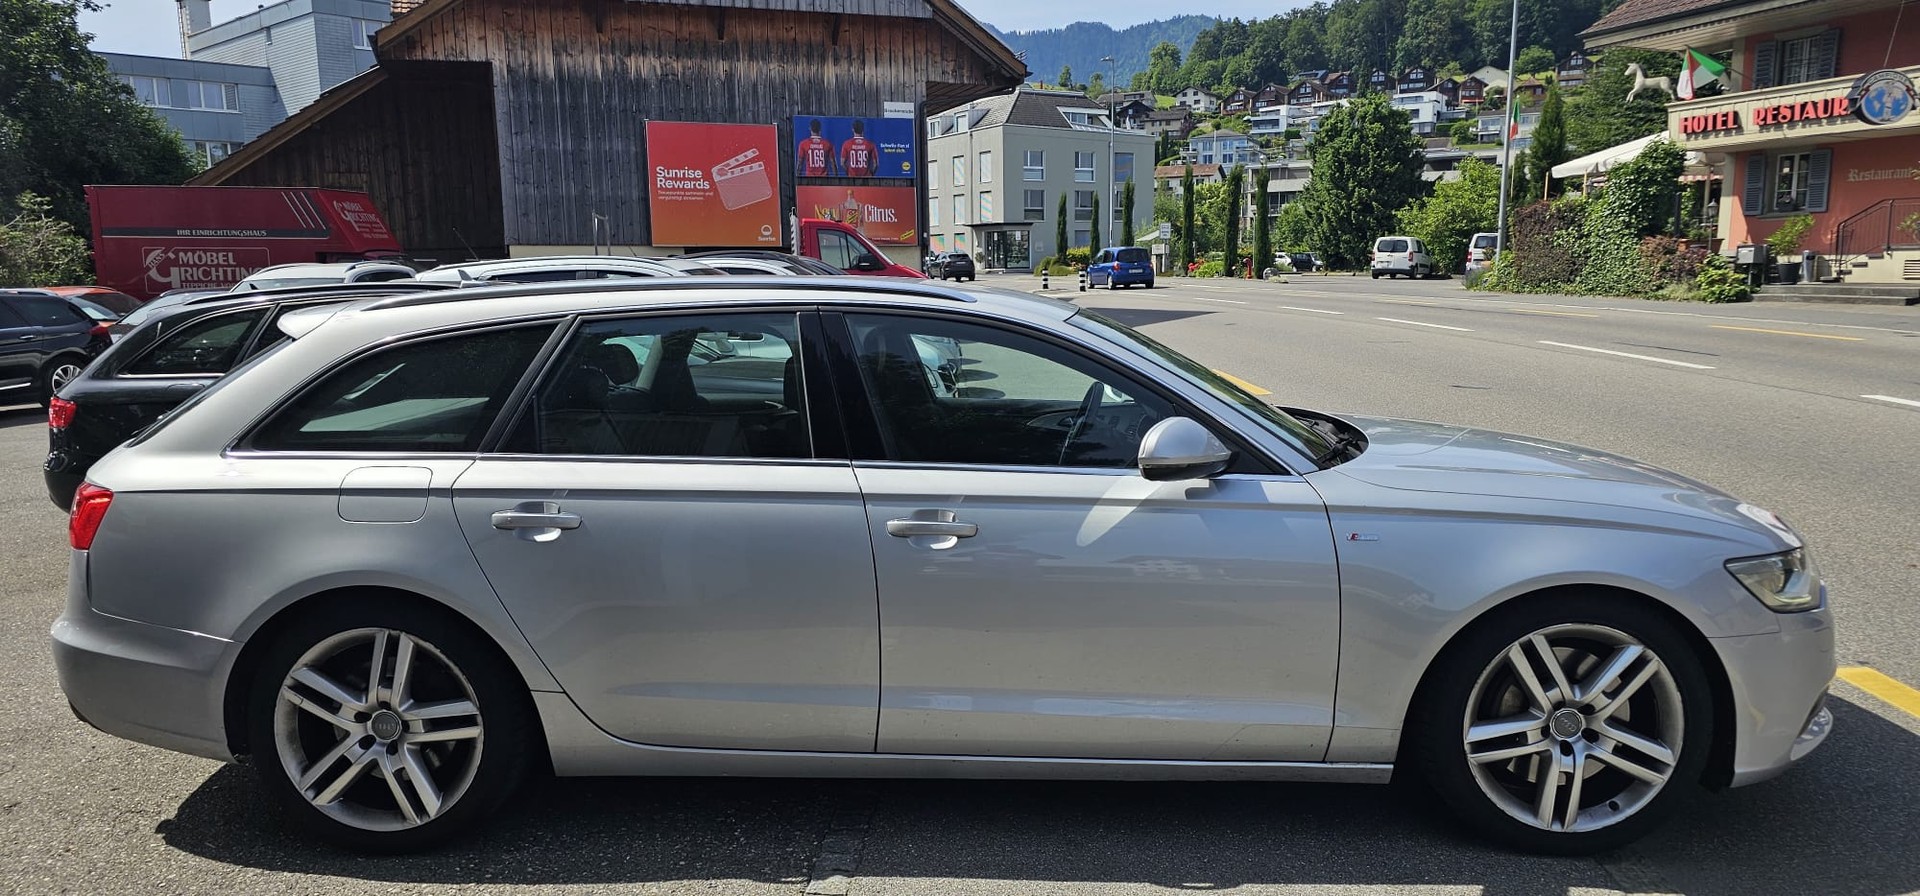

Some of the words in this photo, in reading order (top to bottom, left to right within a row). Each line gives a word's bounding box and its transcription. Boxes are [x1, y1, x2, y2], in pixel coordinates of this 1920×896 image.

[1680, 111, 1738, 134] HOTEL
[1753, 96, 1851, 125] RESTAUR
[808, 149, 825, 168] 1.69
[656, 166, 702, 178] Sunrise
[657, 177, 710, 189] Rewards
[864, 203, 898, 223] Citrus.
[192, 229, 267, 237] EINRICHTUNGSHAUS
[179, 250, 237, 265] MÖBEL
